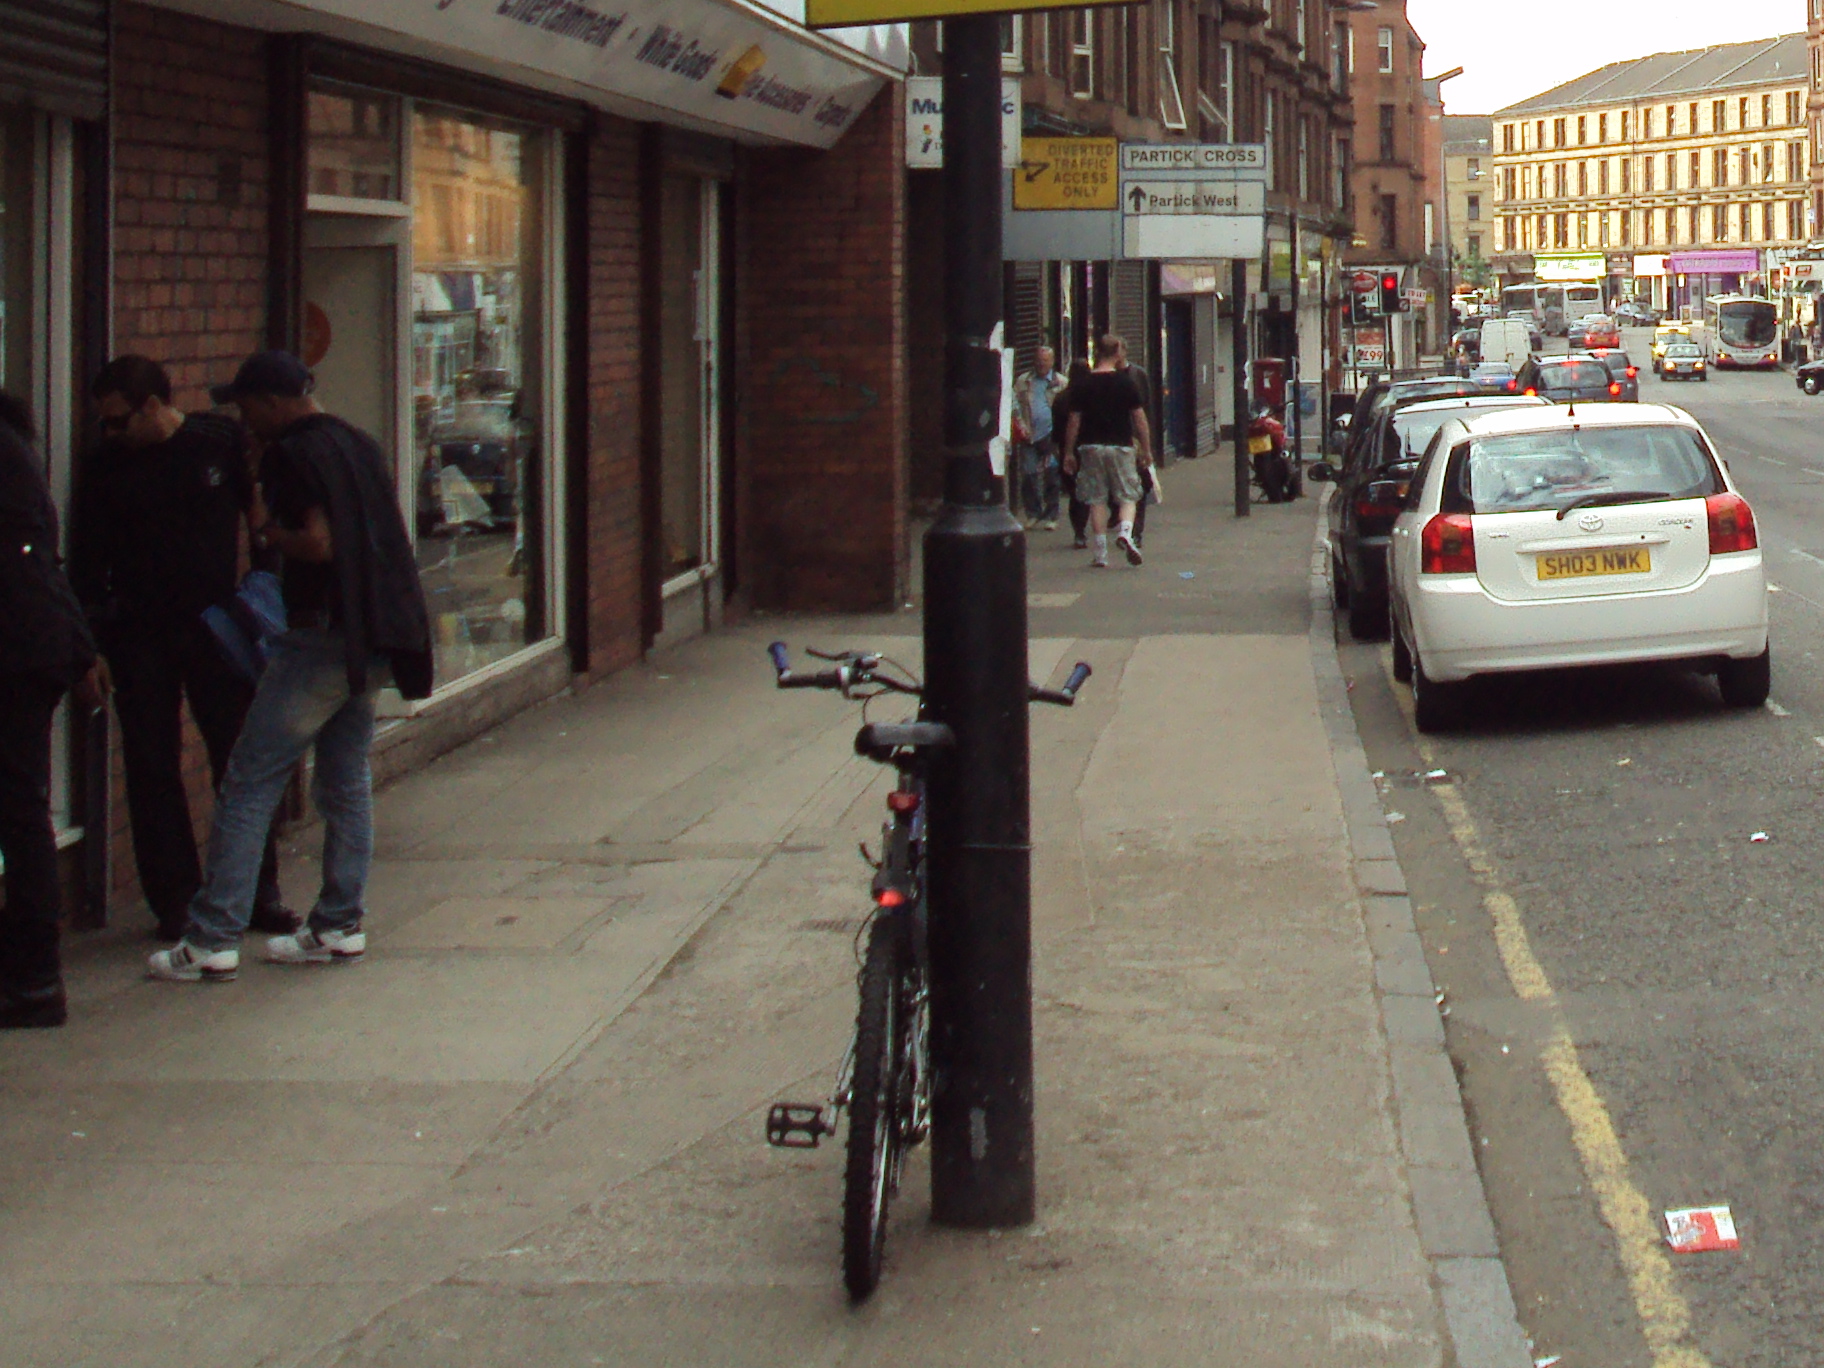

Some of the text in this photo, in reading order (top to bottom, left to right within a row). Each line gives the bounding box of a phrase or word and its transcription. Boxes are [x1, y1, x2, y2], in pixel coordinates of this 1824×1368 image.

[1048, 143, 1114, 157] DIVERTED
[1130, 150, 1257, 163] PARTICK CROSS
[1053, 157, 1108, 170] TRAFFIC
[1053, 172, 1108, 184] ACCESS
[1062, 186, 1099, 198] ONLY
[1149, 194, 1239, 208] Partick West
[1545, 550, 1641, 577] SH03 NWK
